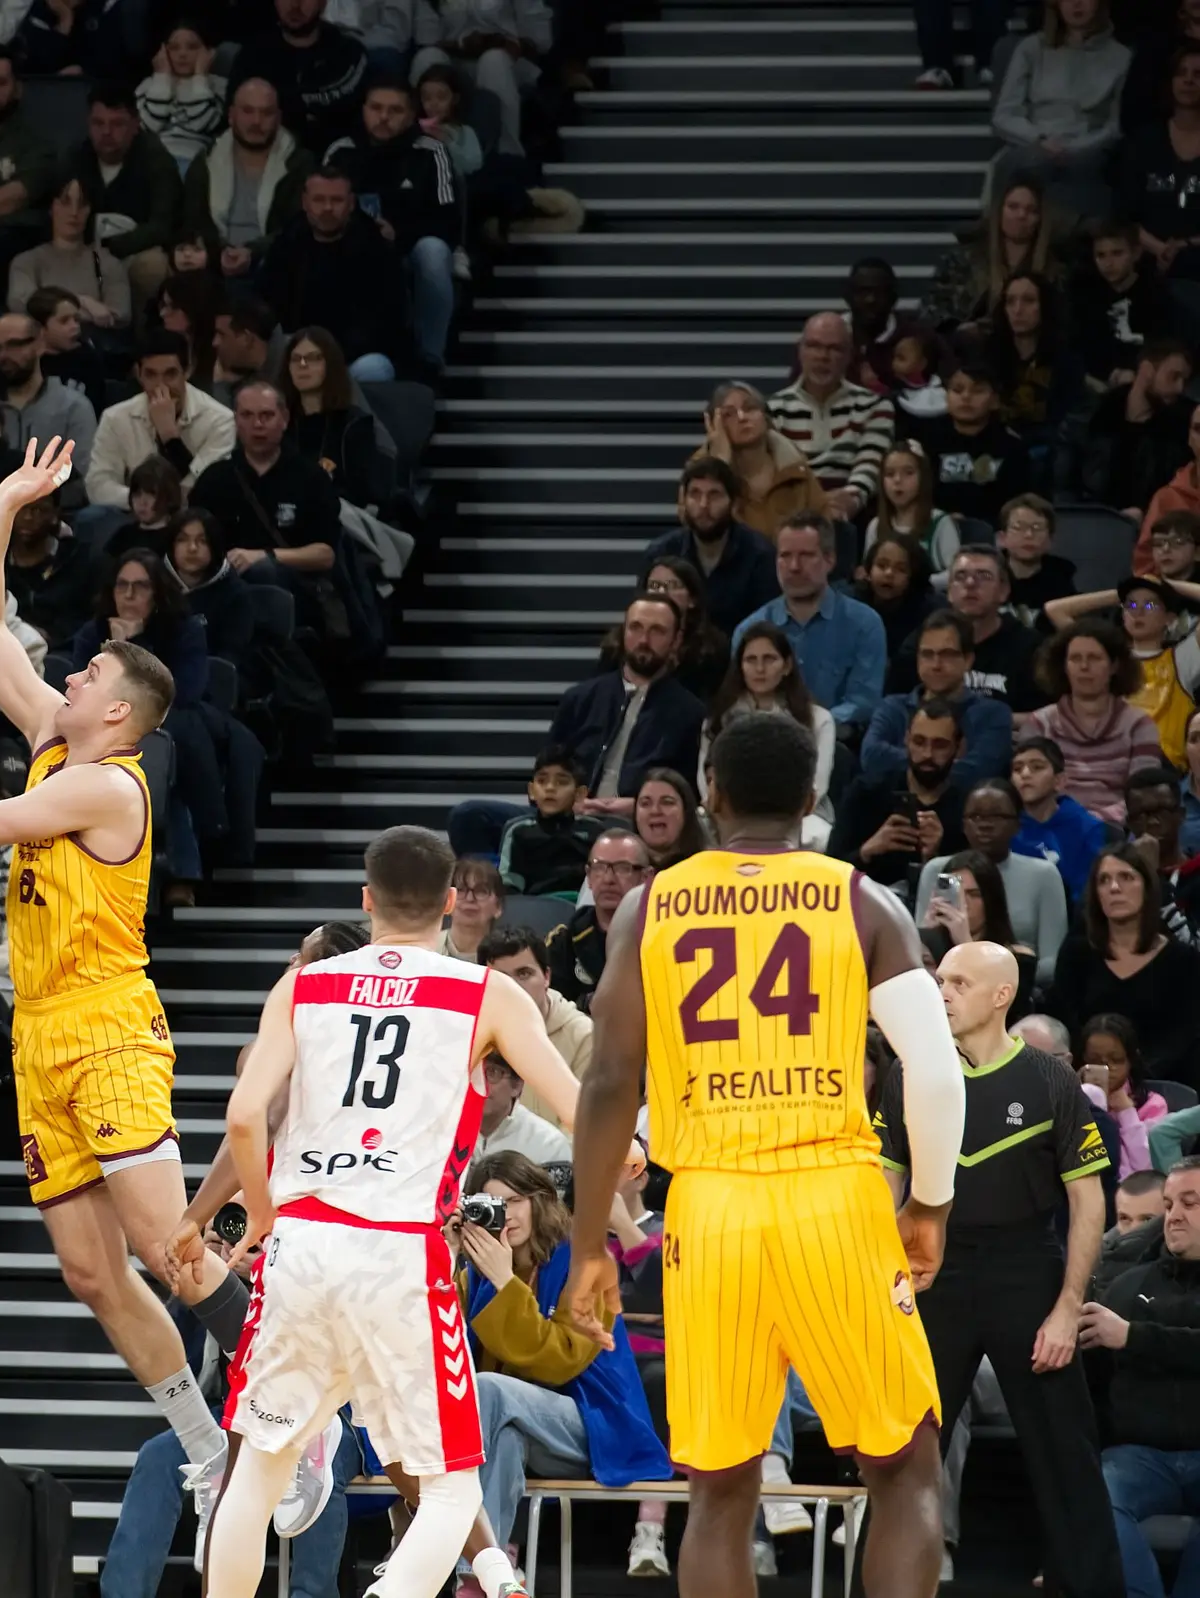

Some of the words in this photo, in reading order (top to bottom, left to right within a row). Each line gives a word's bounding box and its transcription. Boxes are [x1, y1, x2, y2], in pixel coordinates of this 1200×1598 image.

[655, 881, 841, 923] HOUMOUNOU
[347, 976, 419, 1007] FALCOZ
[673, 921, 820, 1046] 24
[150, 1013, 168, 1041] 88
[341, 1013, 411, 1110] 13
[708, 1066, 843, 1101] REALITES
[299, 1150, 399, 1176] SPIE
[1080, 1152, 1095, 1162] LA
[664, 1232, 681, 1272] 24
[165, 1379, 191, 1399] 23
